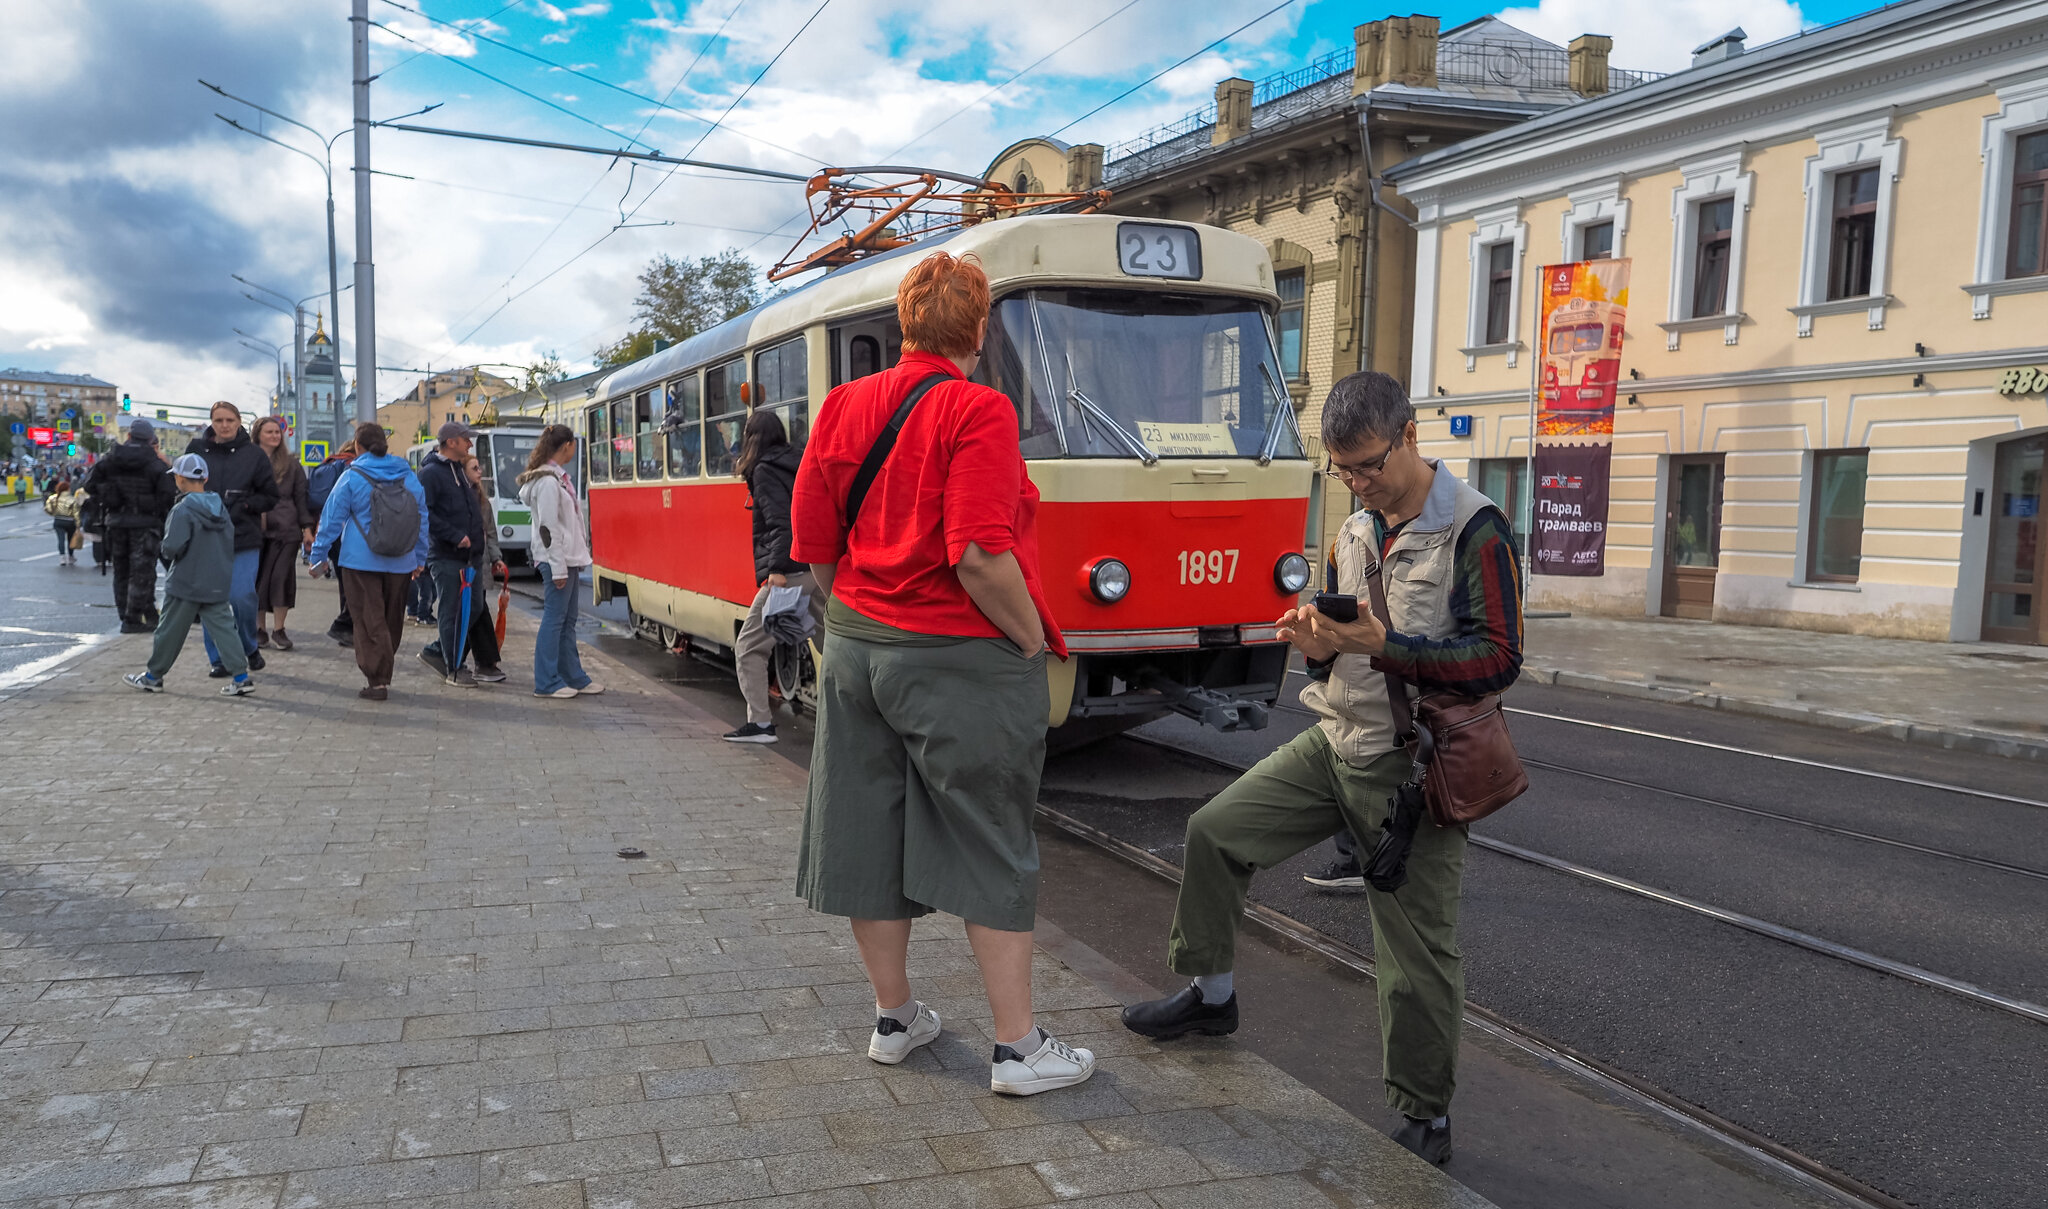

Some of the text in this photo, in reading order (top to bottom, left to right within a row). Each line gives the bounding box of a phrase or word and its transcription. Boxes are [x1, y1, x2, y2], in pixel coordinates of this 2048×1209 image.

[1125, 233, 1177, 271] 23
[1559, 271, 1567, 282] 6
[1456, 418, 1462, 429] 9
[1143, 428, 1163, 442] 23
[1170, 432, 1211, 441] МИХАЛКОВО
[1540, 500, 1582, 517] Парад
[1539, 518, 1602, 532] трамваев
[1573, 551, 1597, 560] ЛЕТО
[1177, 549, 1240, 585] 1897
